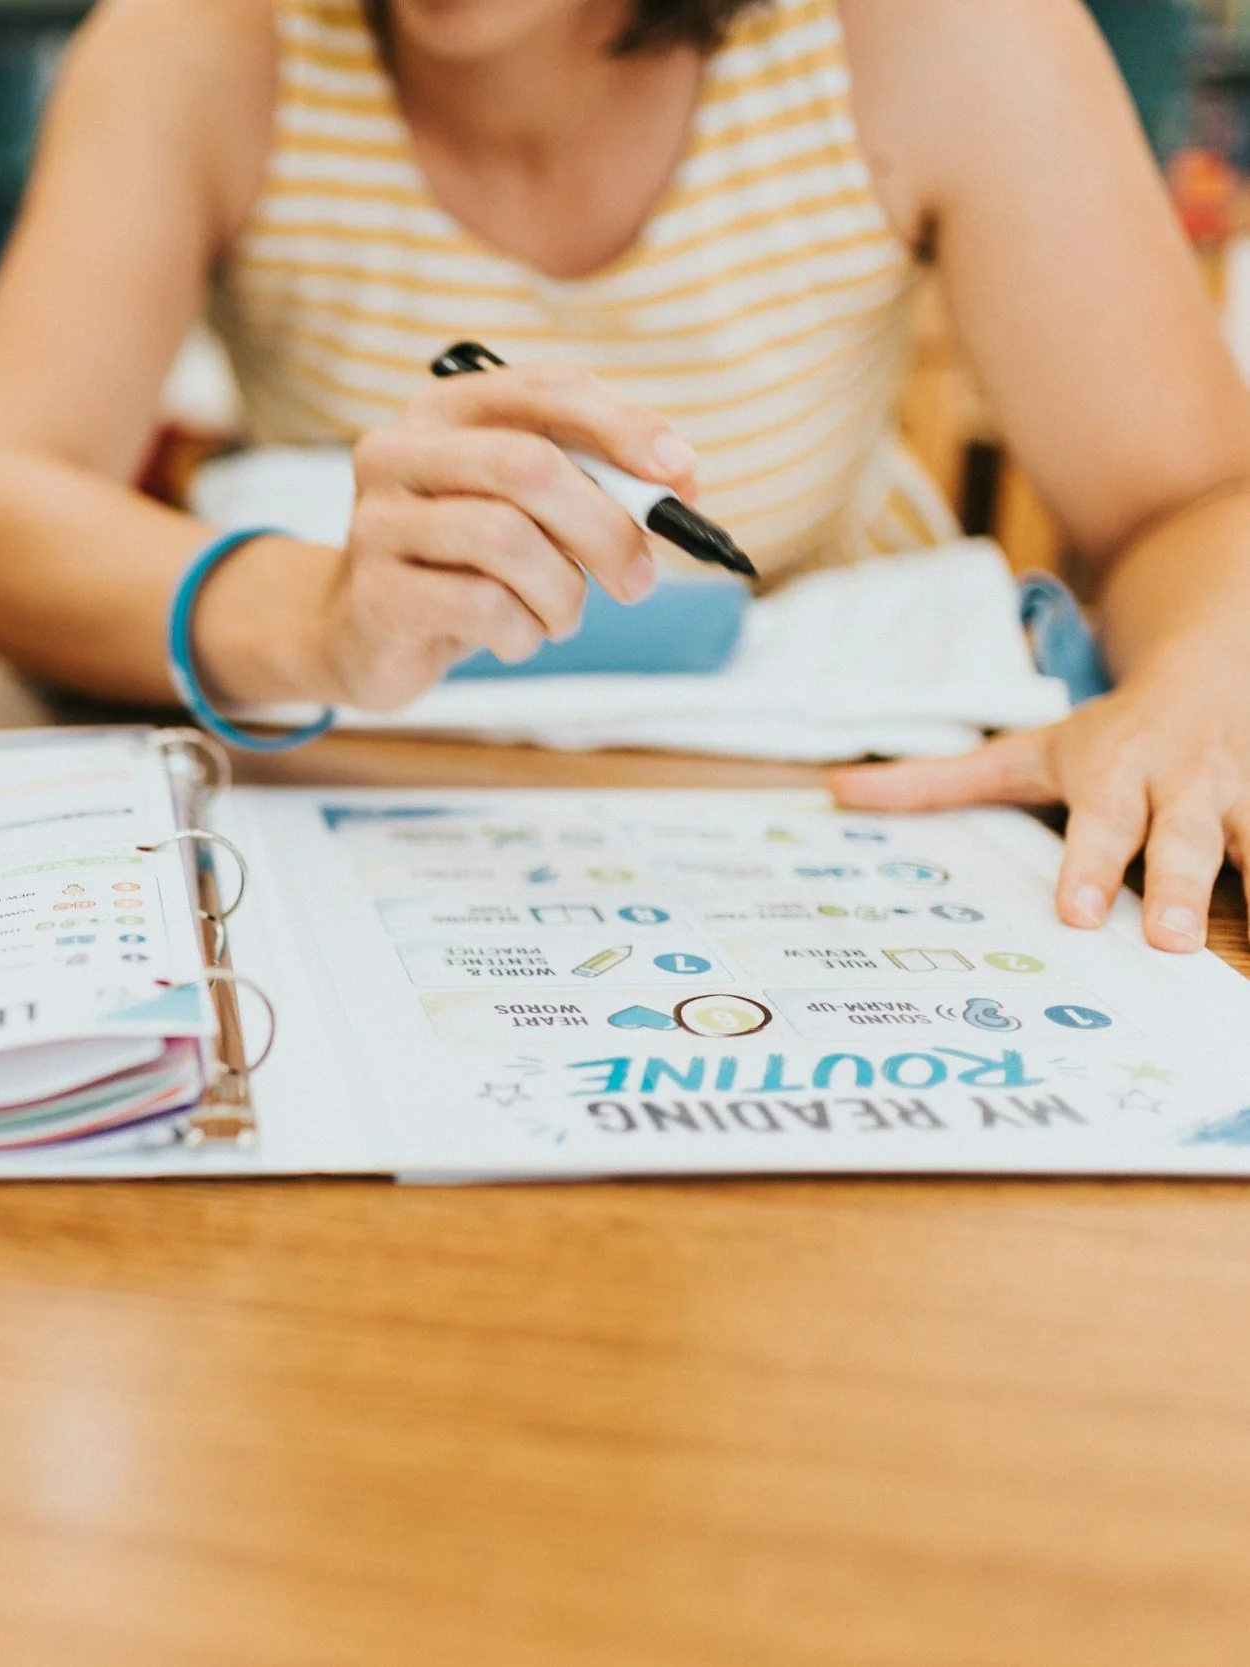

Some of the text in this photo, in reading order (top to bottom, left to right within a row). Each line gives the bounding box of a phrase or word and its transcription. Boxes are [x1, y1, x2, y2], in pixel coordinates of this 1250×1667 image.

[5, 891, 35, 901] NEW
[443, 946, 543, 957] PRACTICE
[784, 948, 867, 959] REVIEW
[443, 957, 549, 967] SENTENCE
[822, 959, 878, 970] RULE
[490, 967, 558, 977] WORD
[493, 1003, 582, 1016] WORDS
[807, 1001, 918, 1013] WARM-UP
[511, 1016, 589, 1028] HEART
[848, 1012, 932, 1026] SOUND
[565, 1047, 1045, 1097] ROUTINE
[587, 1095, 1089, 1133] MY READING
